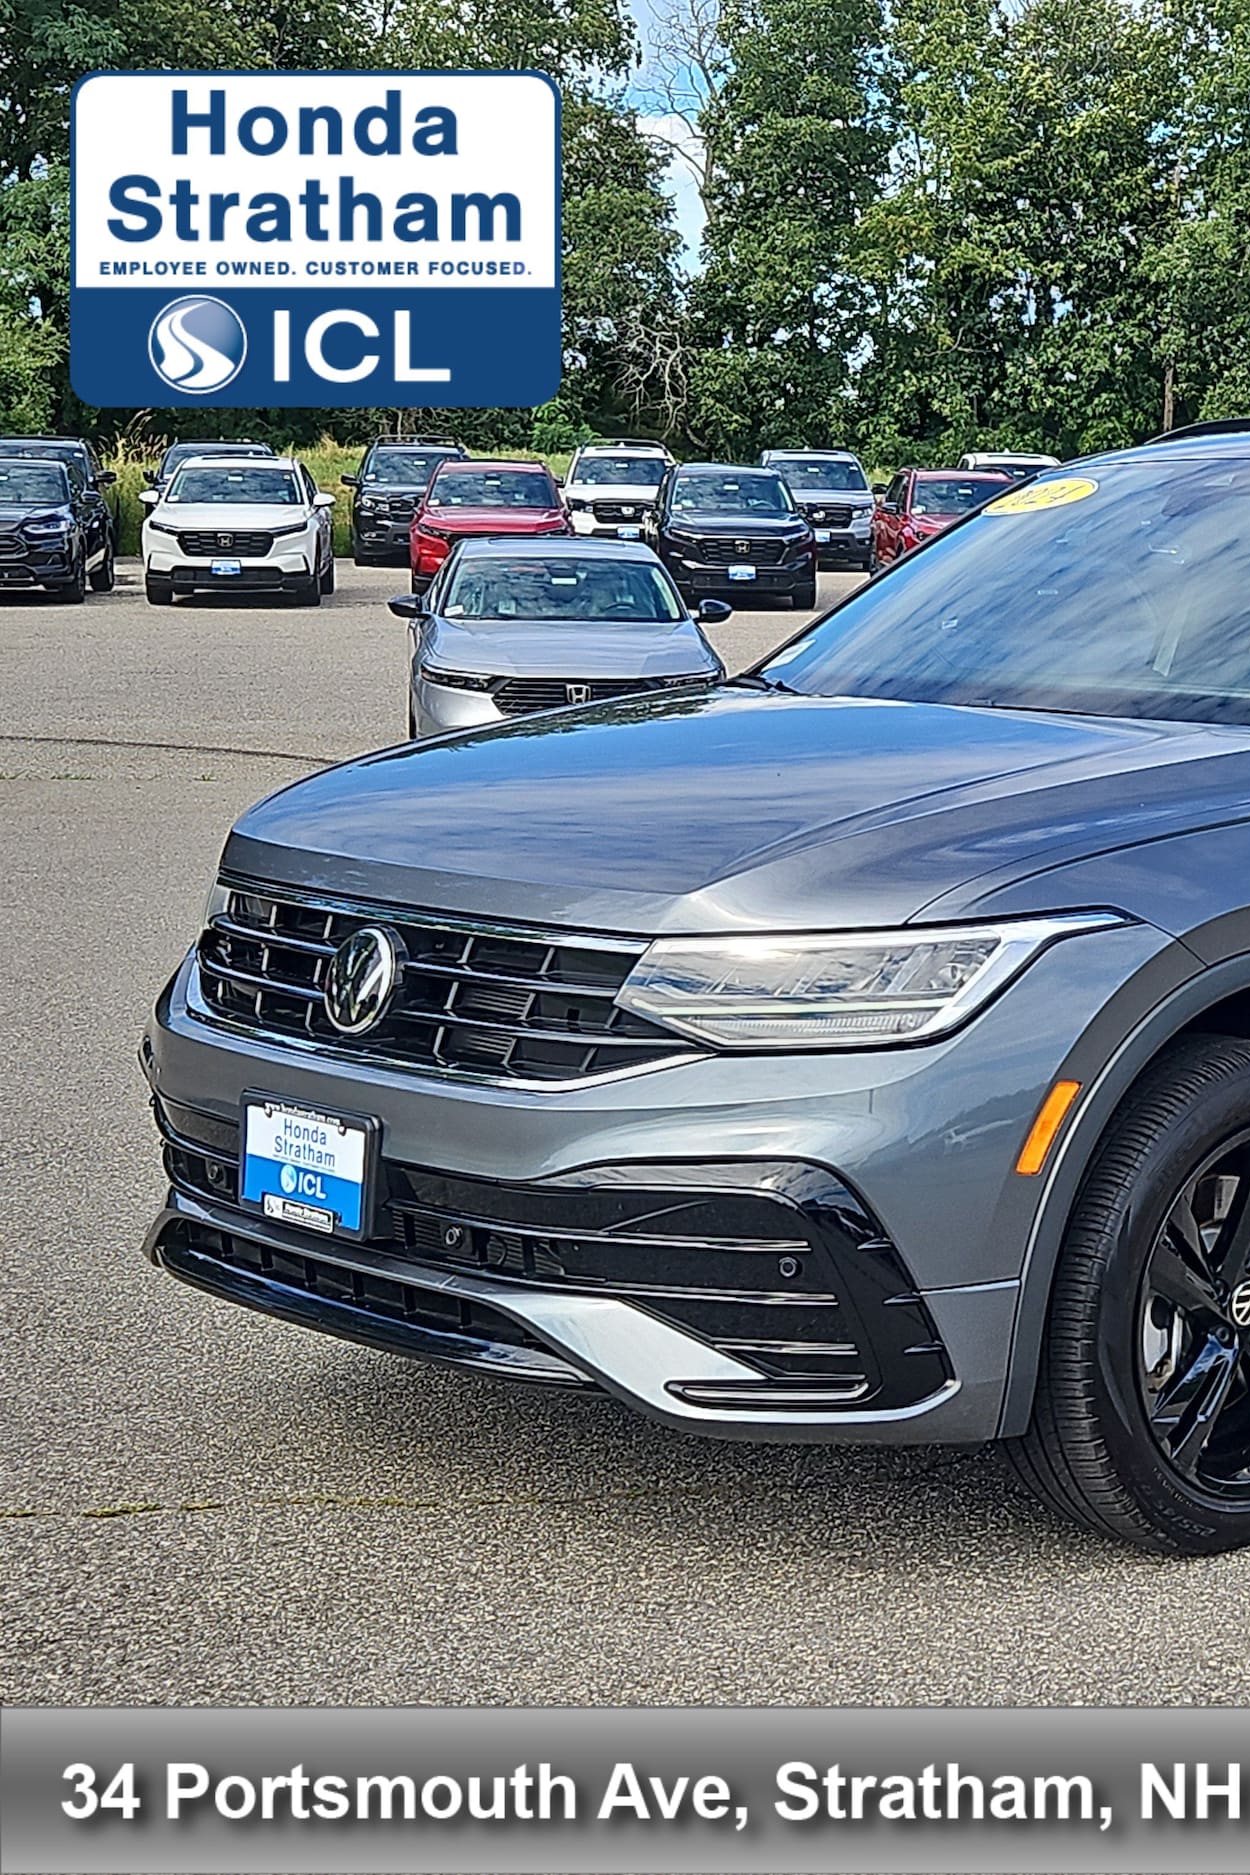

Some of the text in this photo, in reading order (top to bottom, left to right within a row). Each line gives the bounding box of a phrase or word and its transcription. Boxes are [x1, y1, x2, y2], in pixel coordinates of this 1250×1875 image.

[283, 1118, 328, 1146] Honda
[274, 1136, 336, 1168] Stratham
[297, 1172, 328, 1200] ICL
